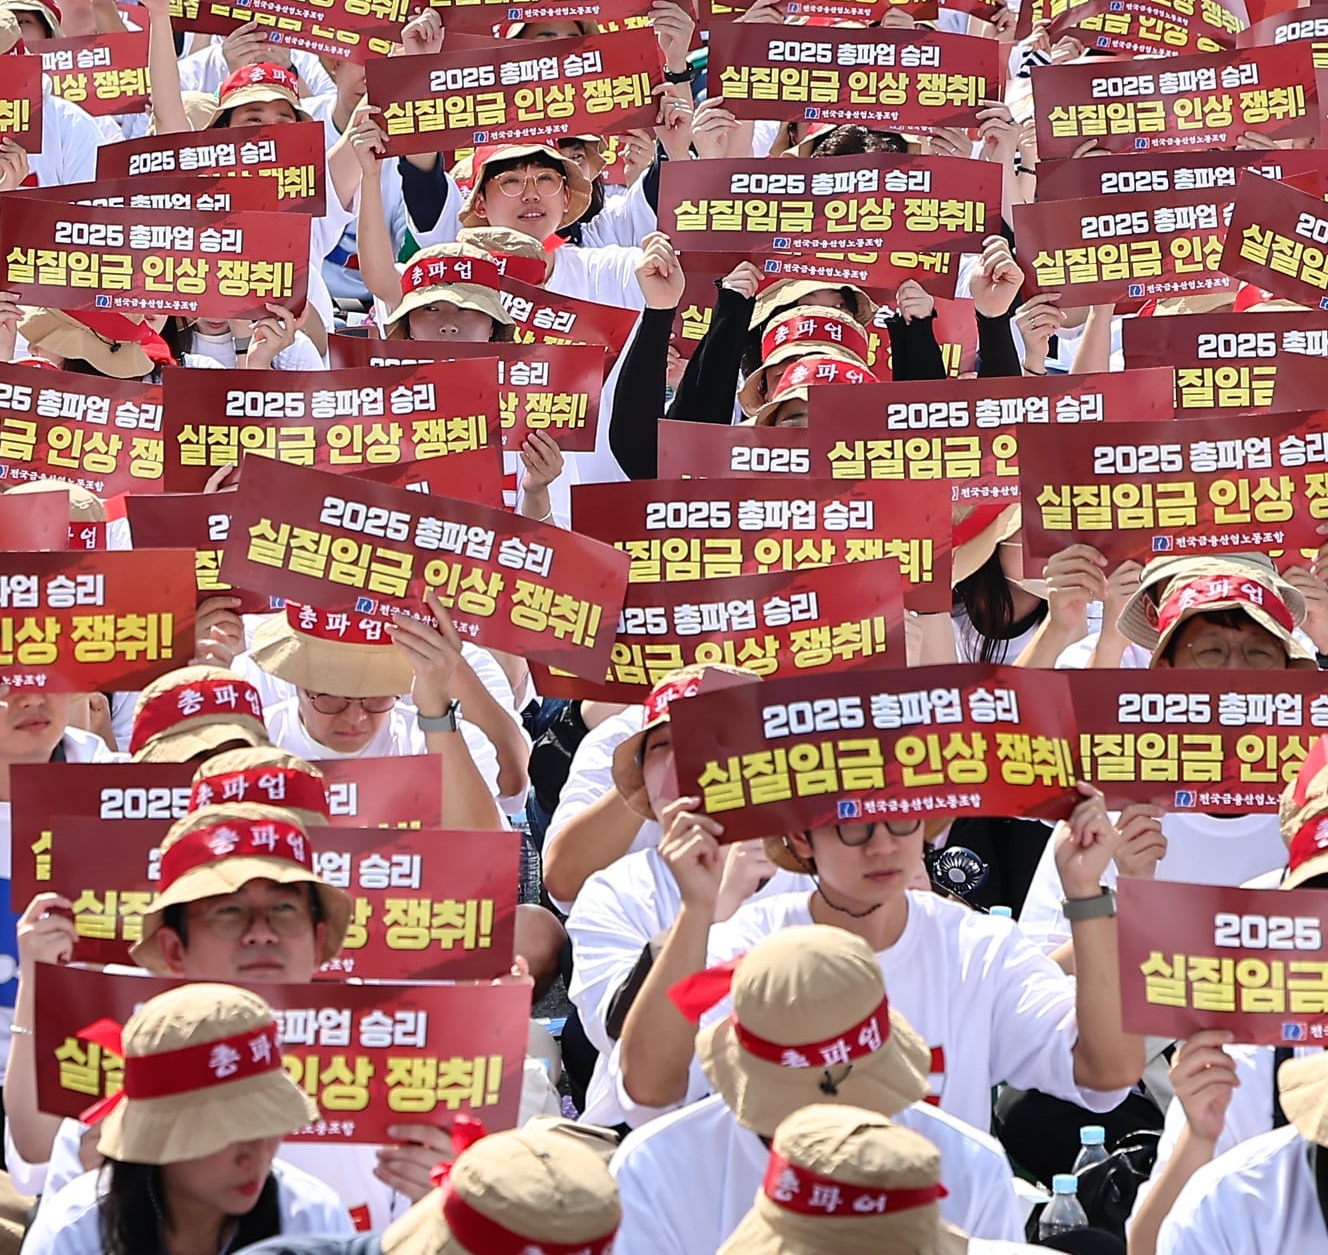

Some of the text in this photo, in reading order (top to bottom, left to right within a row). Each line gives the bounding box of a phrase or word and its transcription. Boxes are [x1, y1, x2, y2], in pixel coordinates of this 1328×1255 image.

[429, 50, 601, 91] 2025 총파업 승리
[379, 71, 662, 142] 실질임금 인상 쟁취!
[411, 261, 473, 286] 총파업
[774, 319, 842, 344] 총파업
[46, 573, 104, 608] 승리
[1177, 578, 1264, 607] 총파업
[70, 612, 173, 662] 쟁취!
[762, 687, 1018, 738] 2025 총파업 승리
[692, 735, 1081, 806] 실질임금 인상 쟁취!
[212, 827, 307, 862] 총파업
